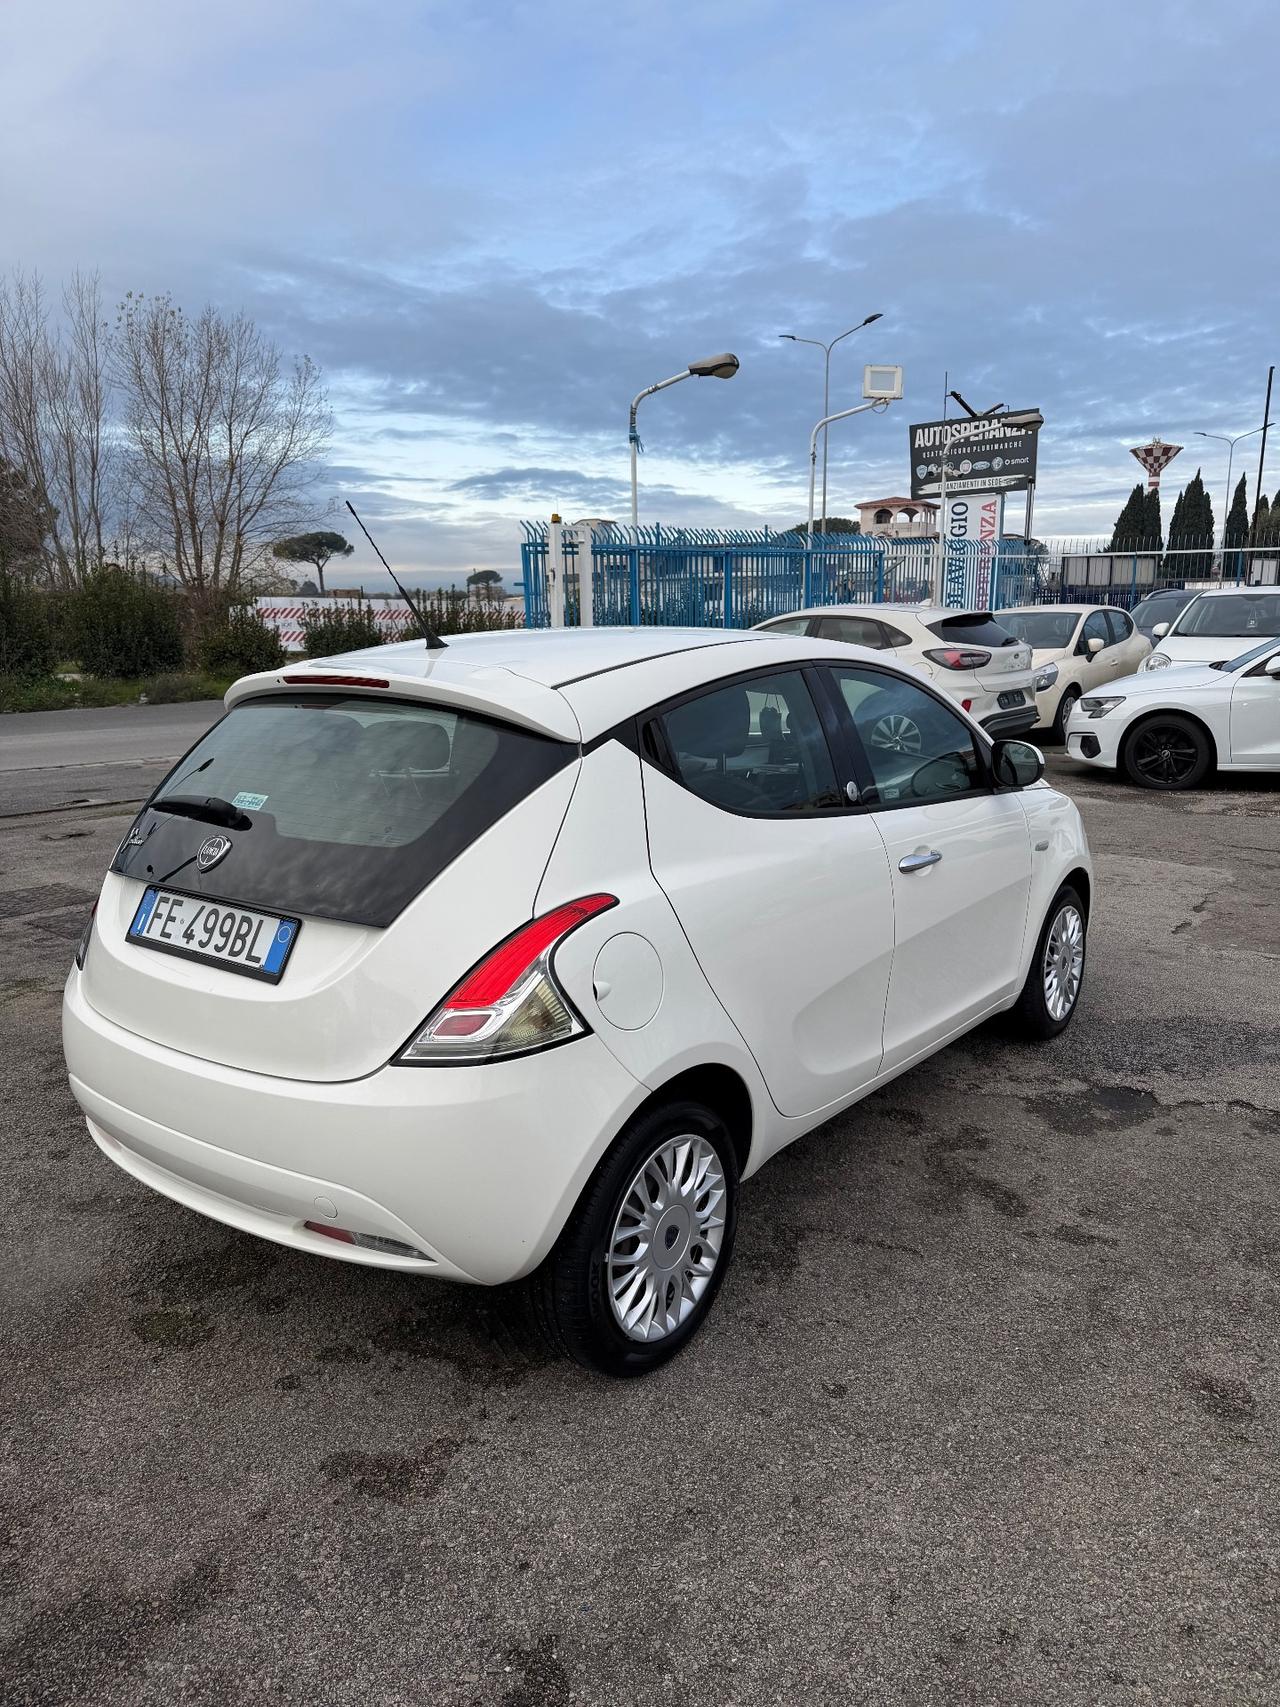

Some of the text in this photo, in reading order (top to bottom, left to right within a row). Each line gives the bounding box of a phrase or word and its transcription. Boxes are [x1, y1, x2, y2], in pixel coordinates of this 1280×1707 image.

[973, 440, 1023, 452] PLURIMARCHE
[1010, 457, 1030, 465] smart
[937, 479, 980, 491] FIANZIAMENTI
[987, 477, 1002, 487] SEDE
[146, 896, 184, 939] FE
[182, 905, 264, 963] 499BL
